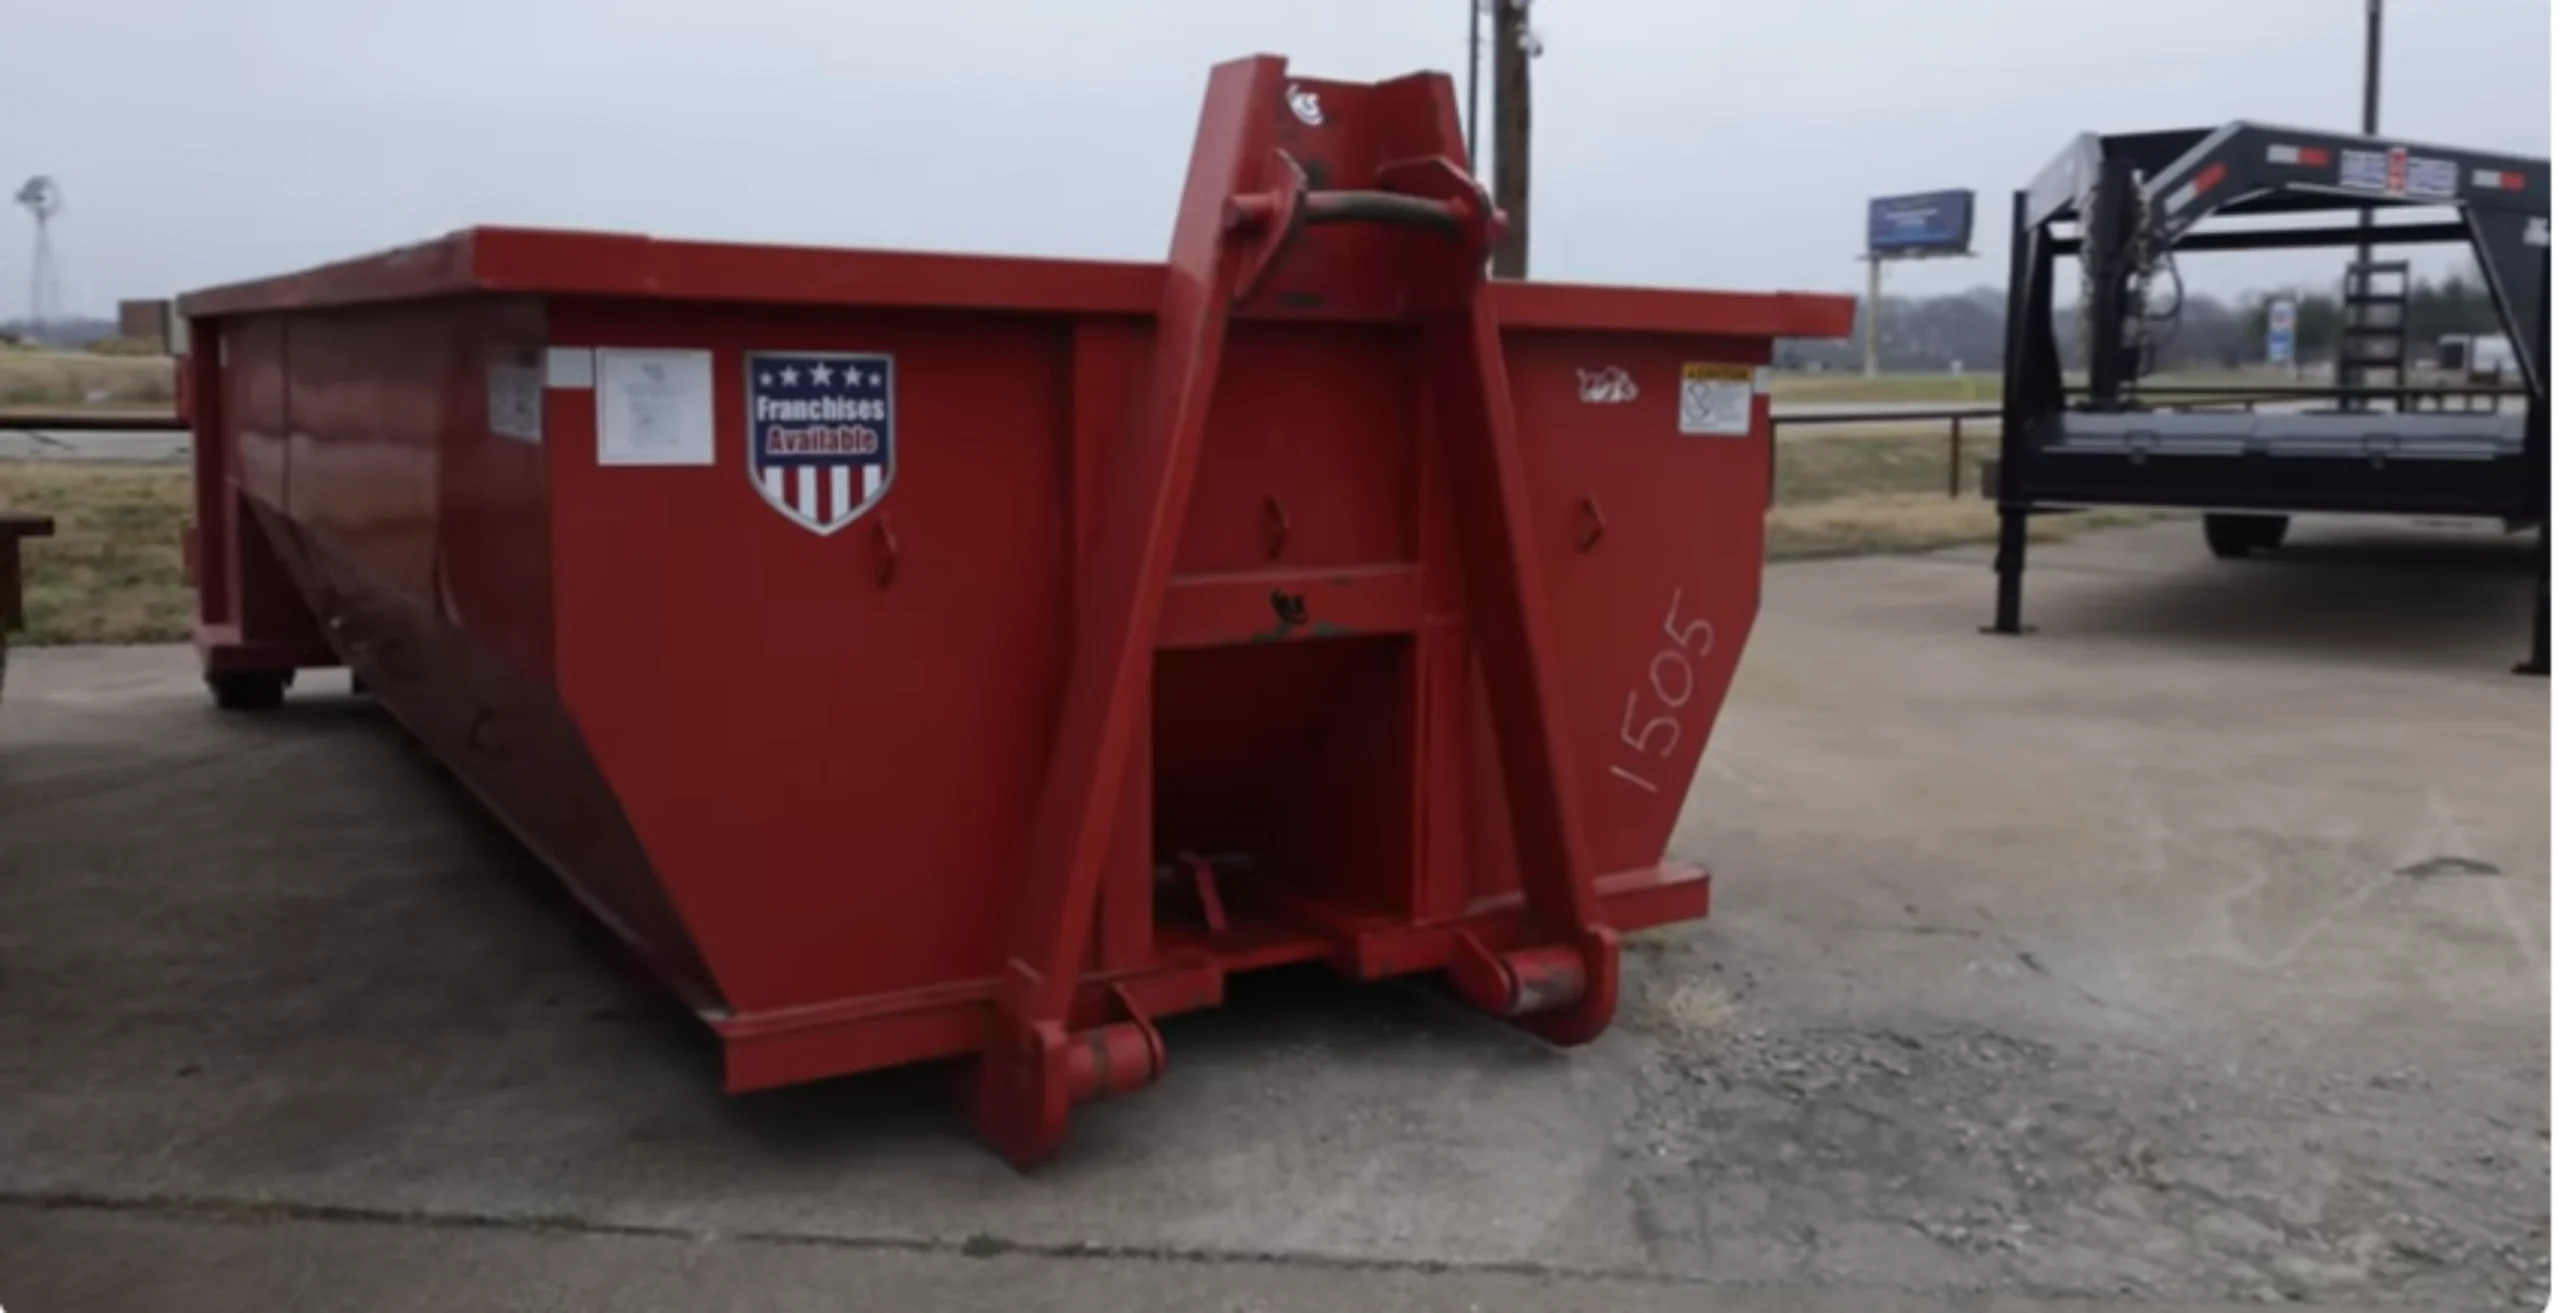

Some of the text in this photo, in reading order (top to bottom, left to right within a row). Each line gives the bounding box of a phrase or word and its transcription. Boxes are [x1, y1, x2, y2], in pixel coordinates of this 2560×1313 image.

[757, 396, 885, 421] Franchises
[767, 425, 878, 453] Available
[1610, 587, 1714, 793] 1505
